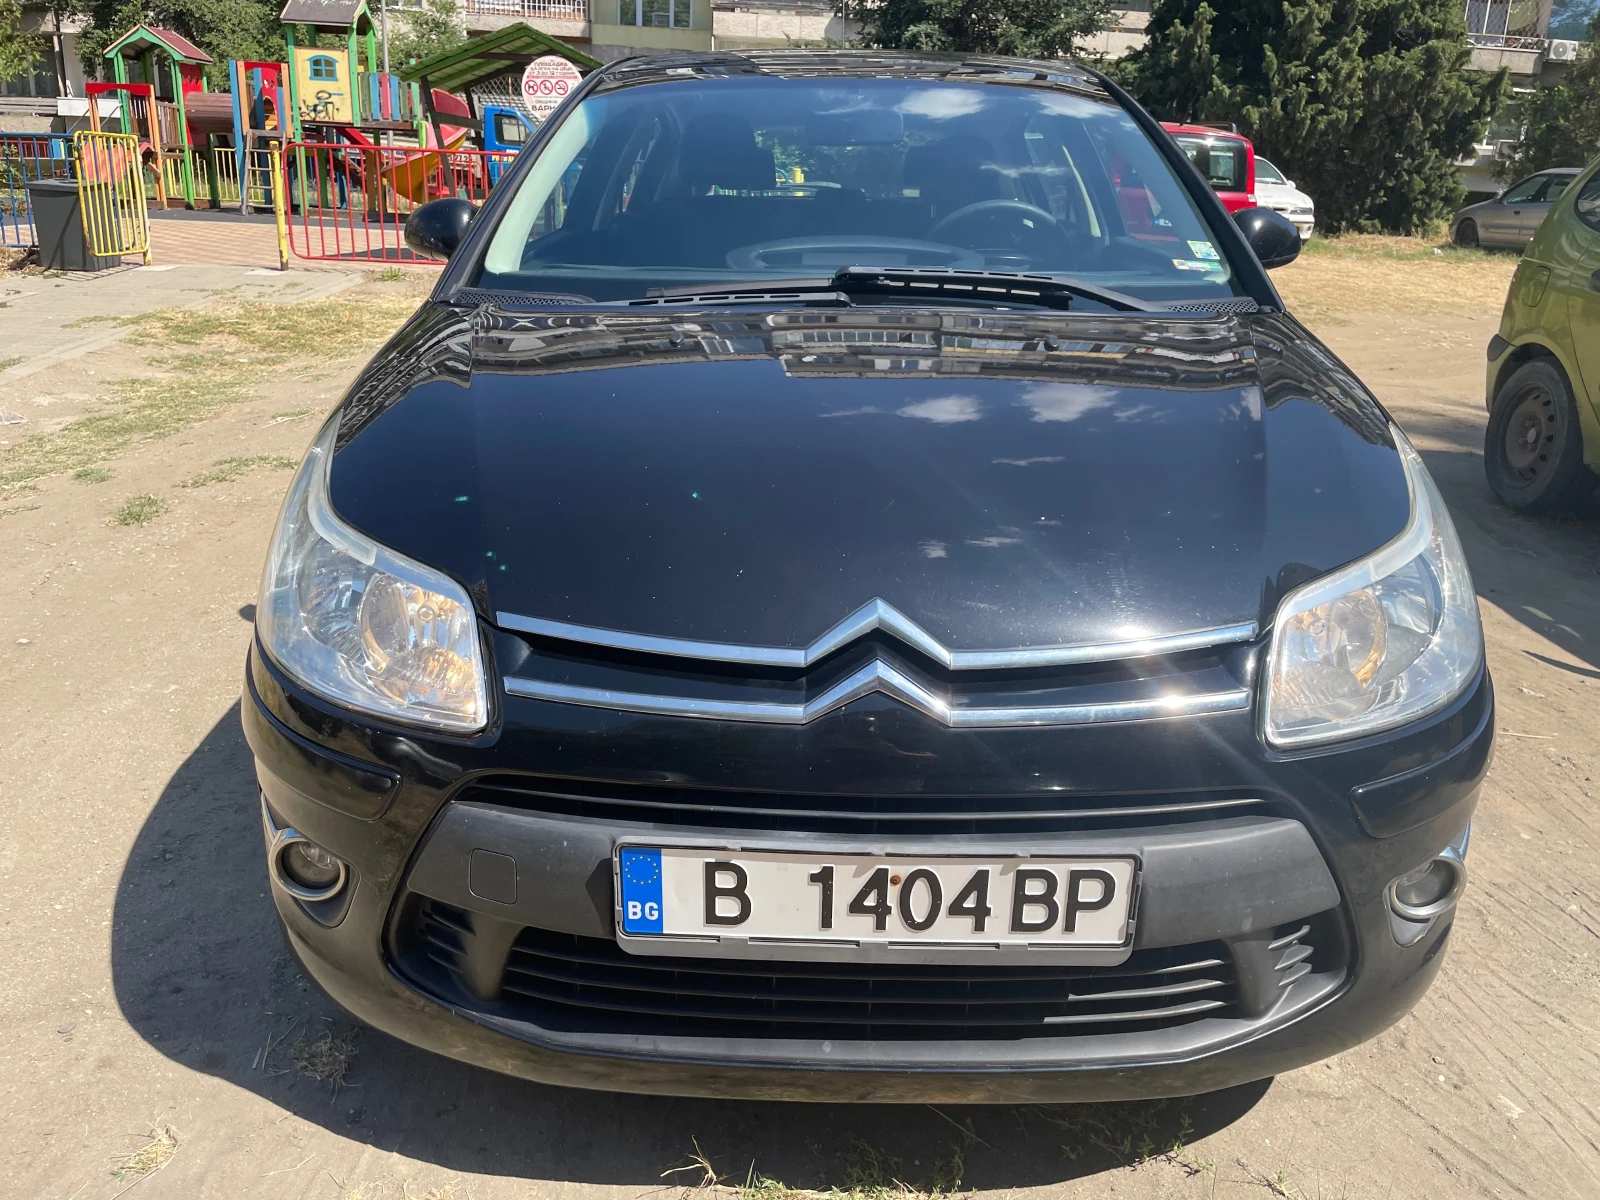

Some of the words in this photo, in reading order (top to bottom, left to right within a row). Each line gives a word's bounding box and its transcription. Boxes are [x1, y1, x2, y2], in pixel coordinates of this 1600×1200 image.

[628, 901, 659, 920] BG
[705, 861, 751, 925] B
[810, 866, 992, 932] 1404
[1011, 869, 1116, 932] BP
